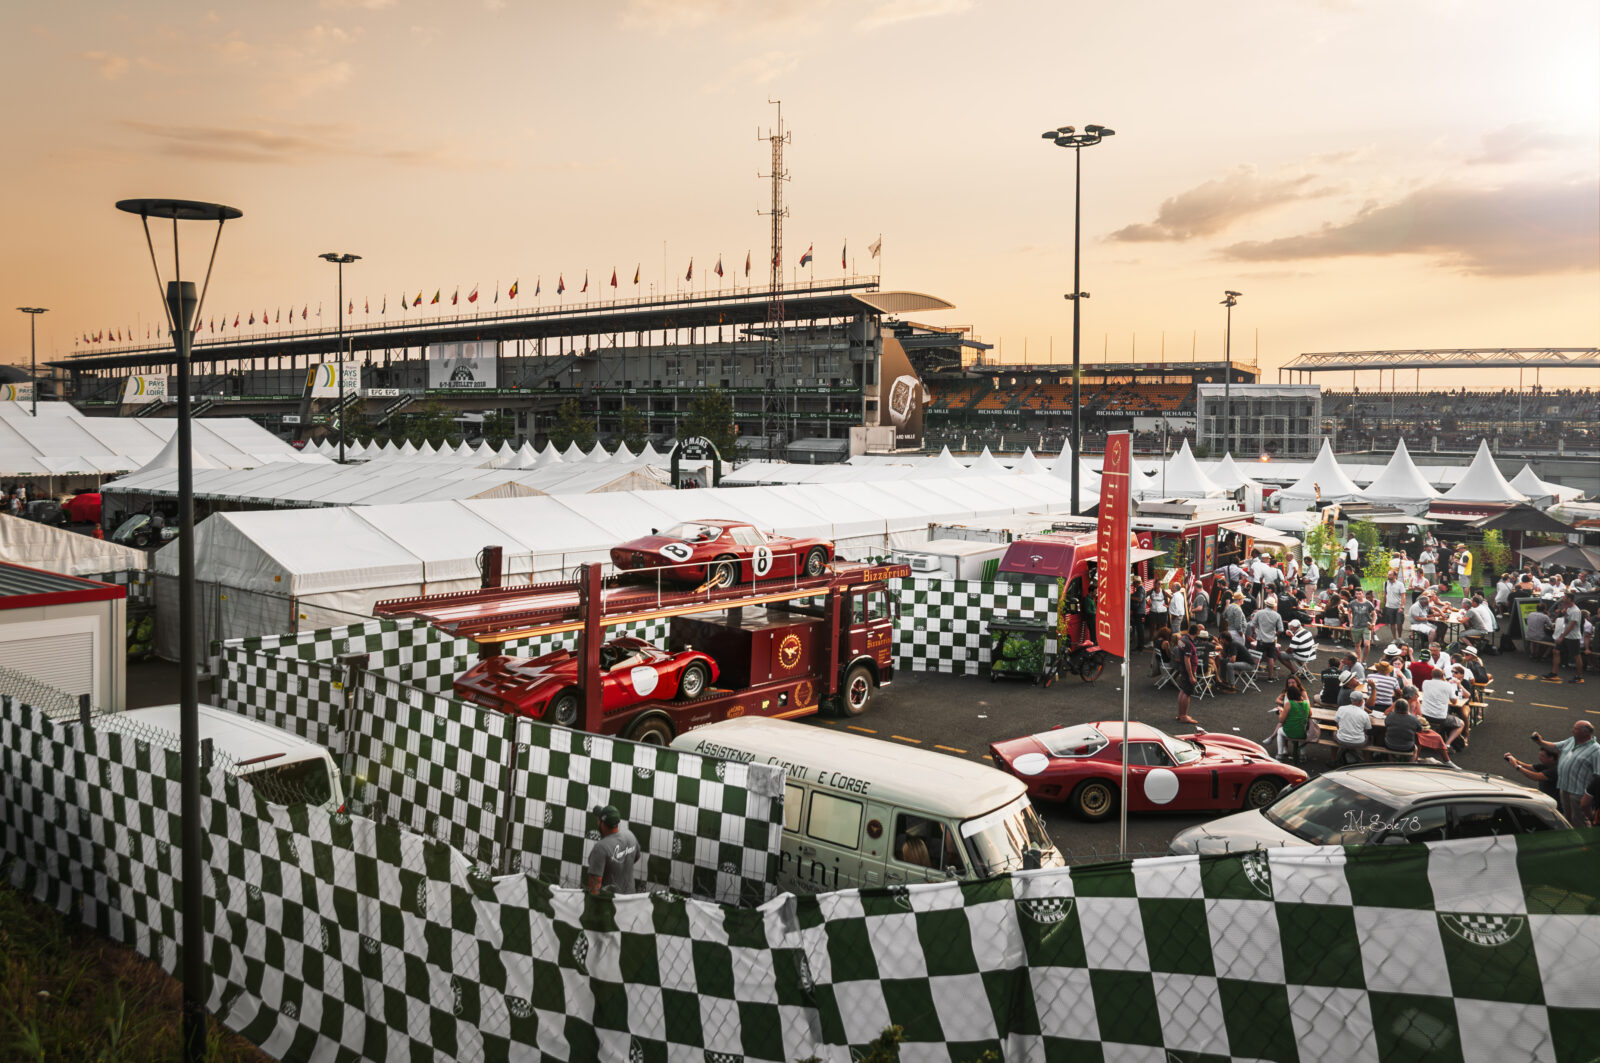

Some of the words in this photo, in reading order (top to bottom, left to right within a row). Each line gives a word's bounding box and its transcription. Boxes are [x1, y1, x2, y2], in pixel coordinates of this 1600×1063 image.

[146, 388, 165, 396] LOIRE
[681, 439, 688, 448] LE
[689, 437, 708, 449] MANS
[664, 545, 689, 558] 8
[757, 548, 768, 573] 8
[863, 566, 909, 582] Bizzarrini
[829, 772, 871, 796] CORSE
[779, 846, 840, 890] rini
